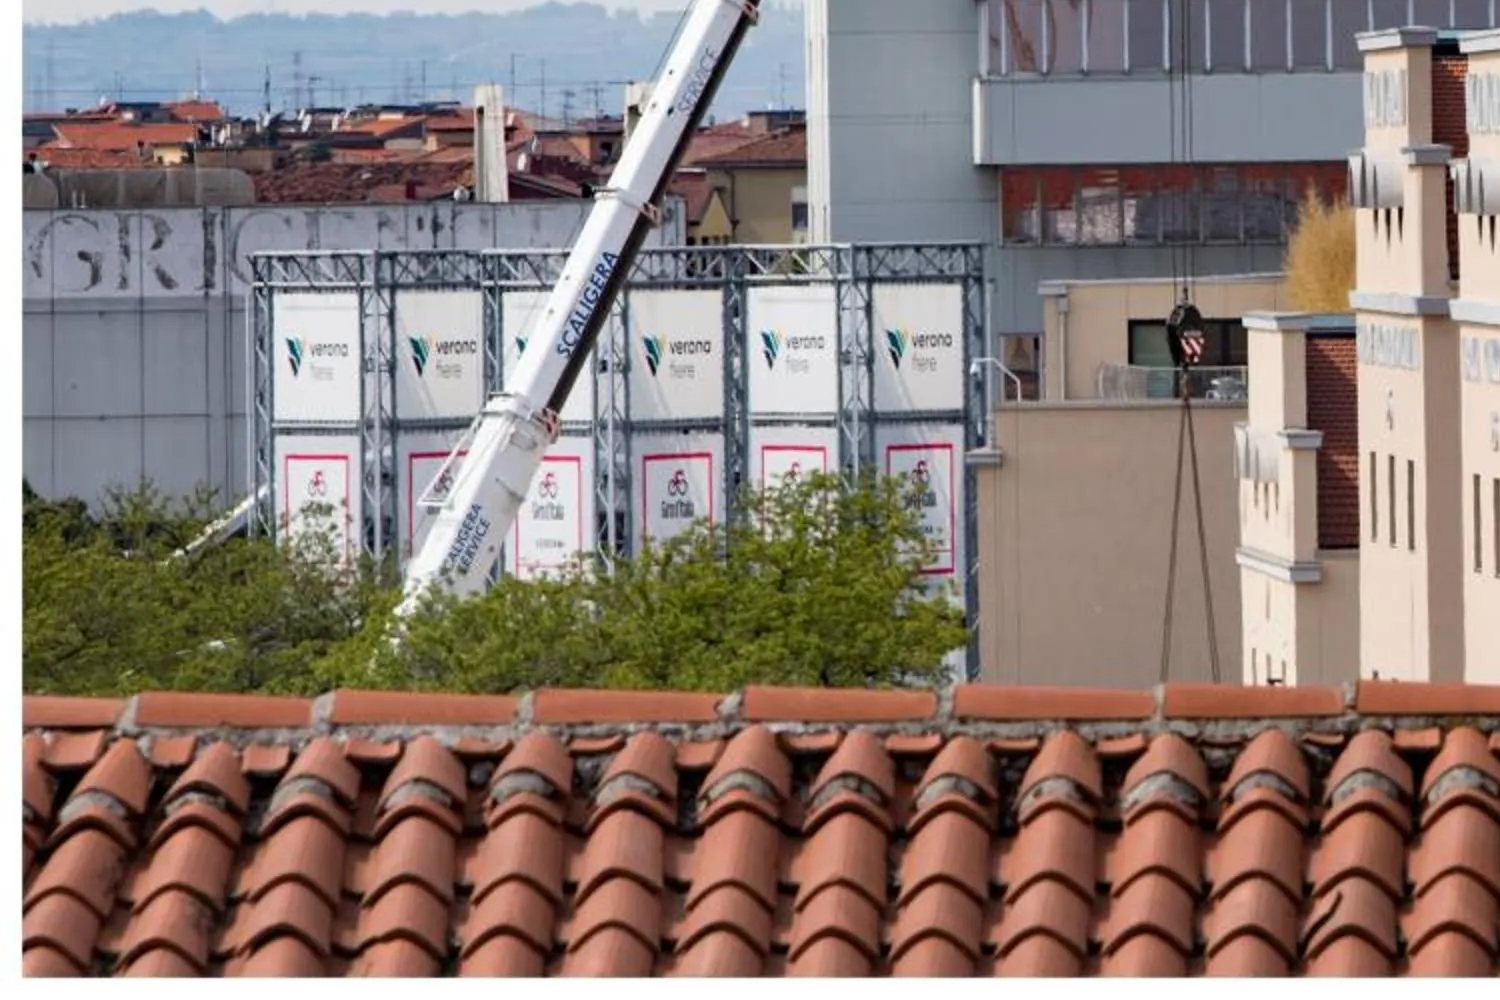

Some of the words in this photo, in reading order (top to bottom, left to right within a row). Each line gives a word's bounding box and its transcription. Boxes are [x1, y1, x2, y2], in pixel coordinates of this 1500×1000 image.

[556, 251, 620, 358] SCALIGERA
[668, 339, 712, 354] verona
[910, 332, 954, 349] verona
[459, 517, 491, 573] ERVICE
